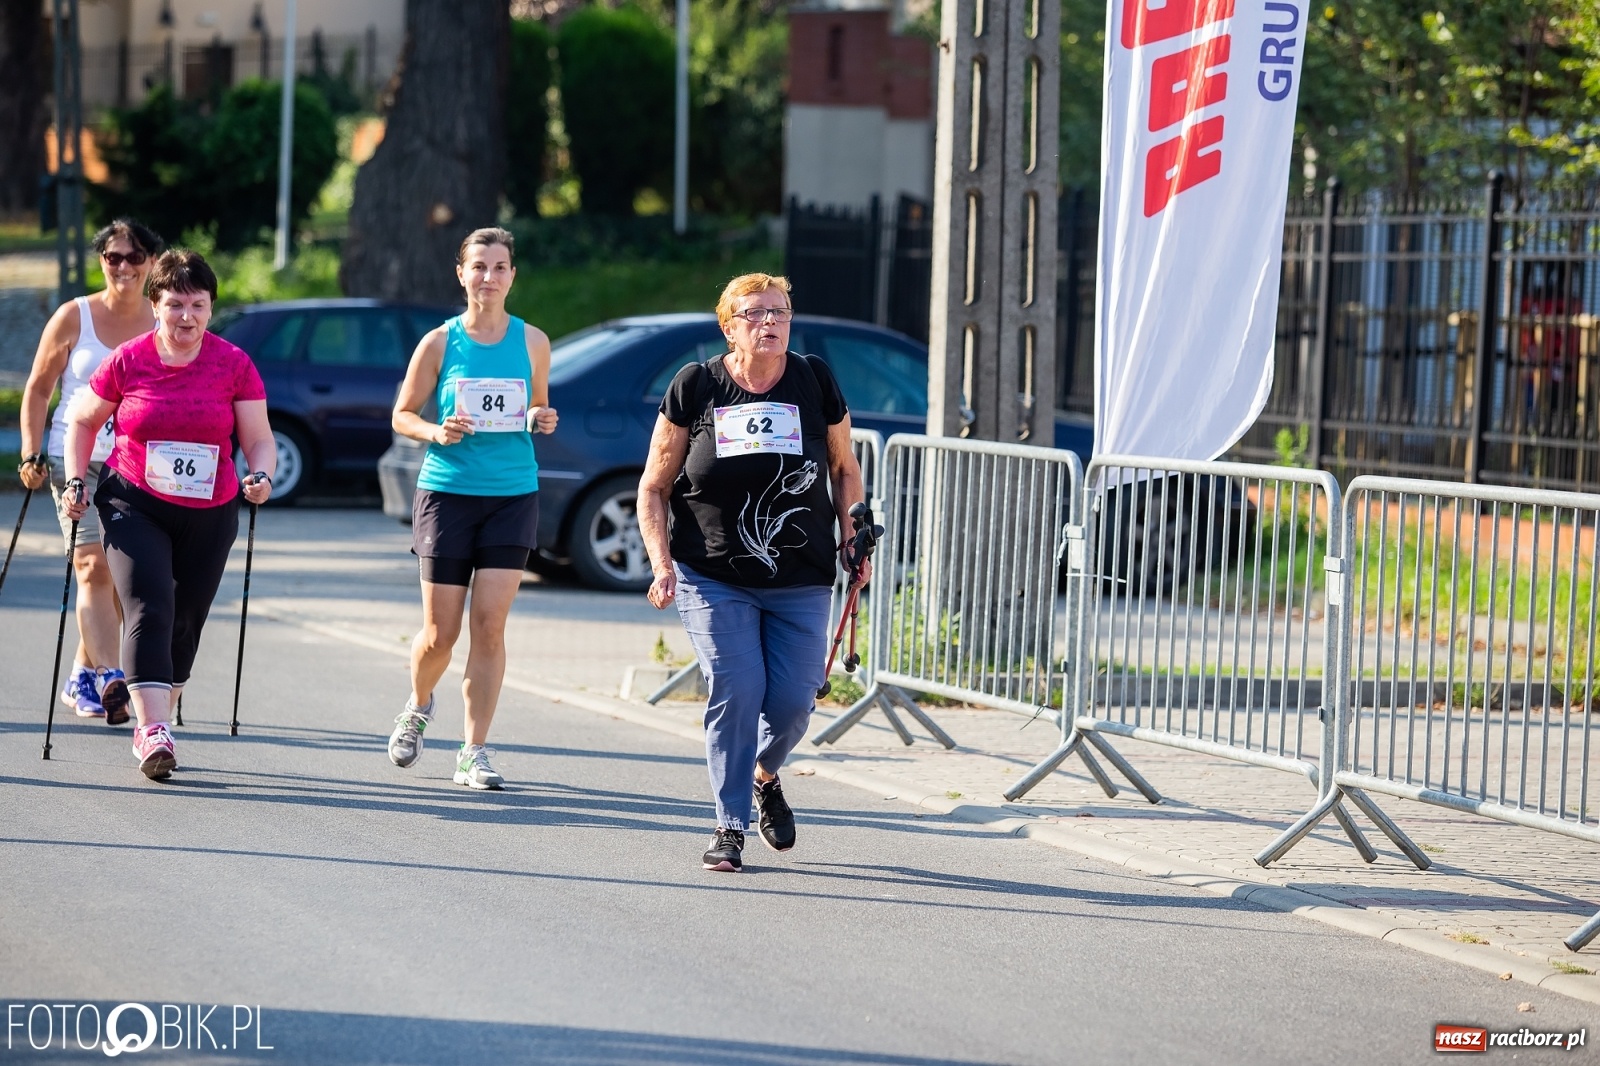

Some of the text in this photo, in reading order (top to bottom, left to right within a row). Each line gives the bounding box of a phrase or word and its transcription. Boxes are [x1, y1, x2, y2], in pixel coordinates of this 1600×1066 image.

[482, 394, 505, 412] 84
[746, 416, 774, 435] 62
[173, 457, 196, 477] 86
